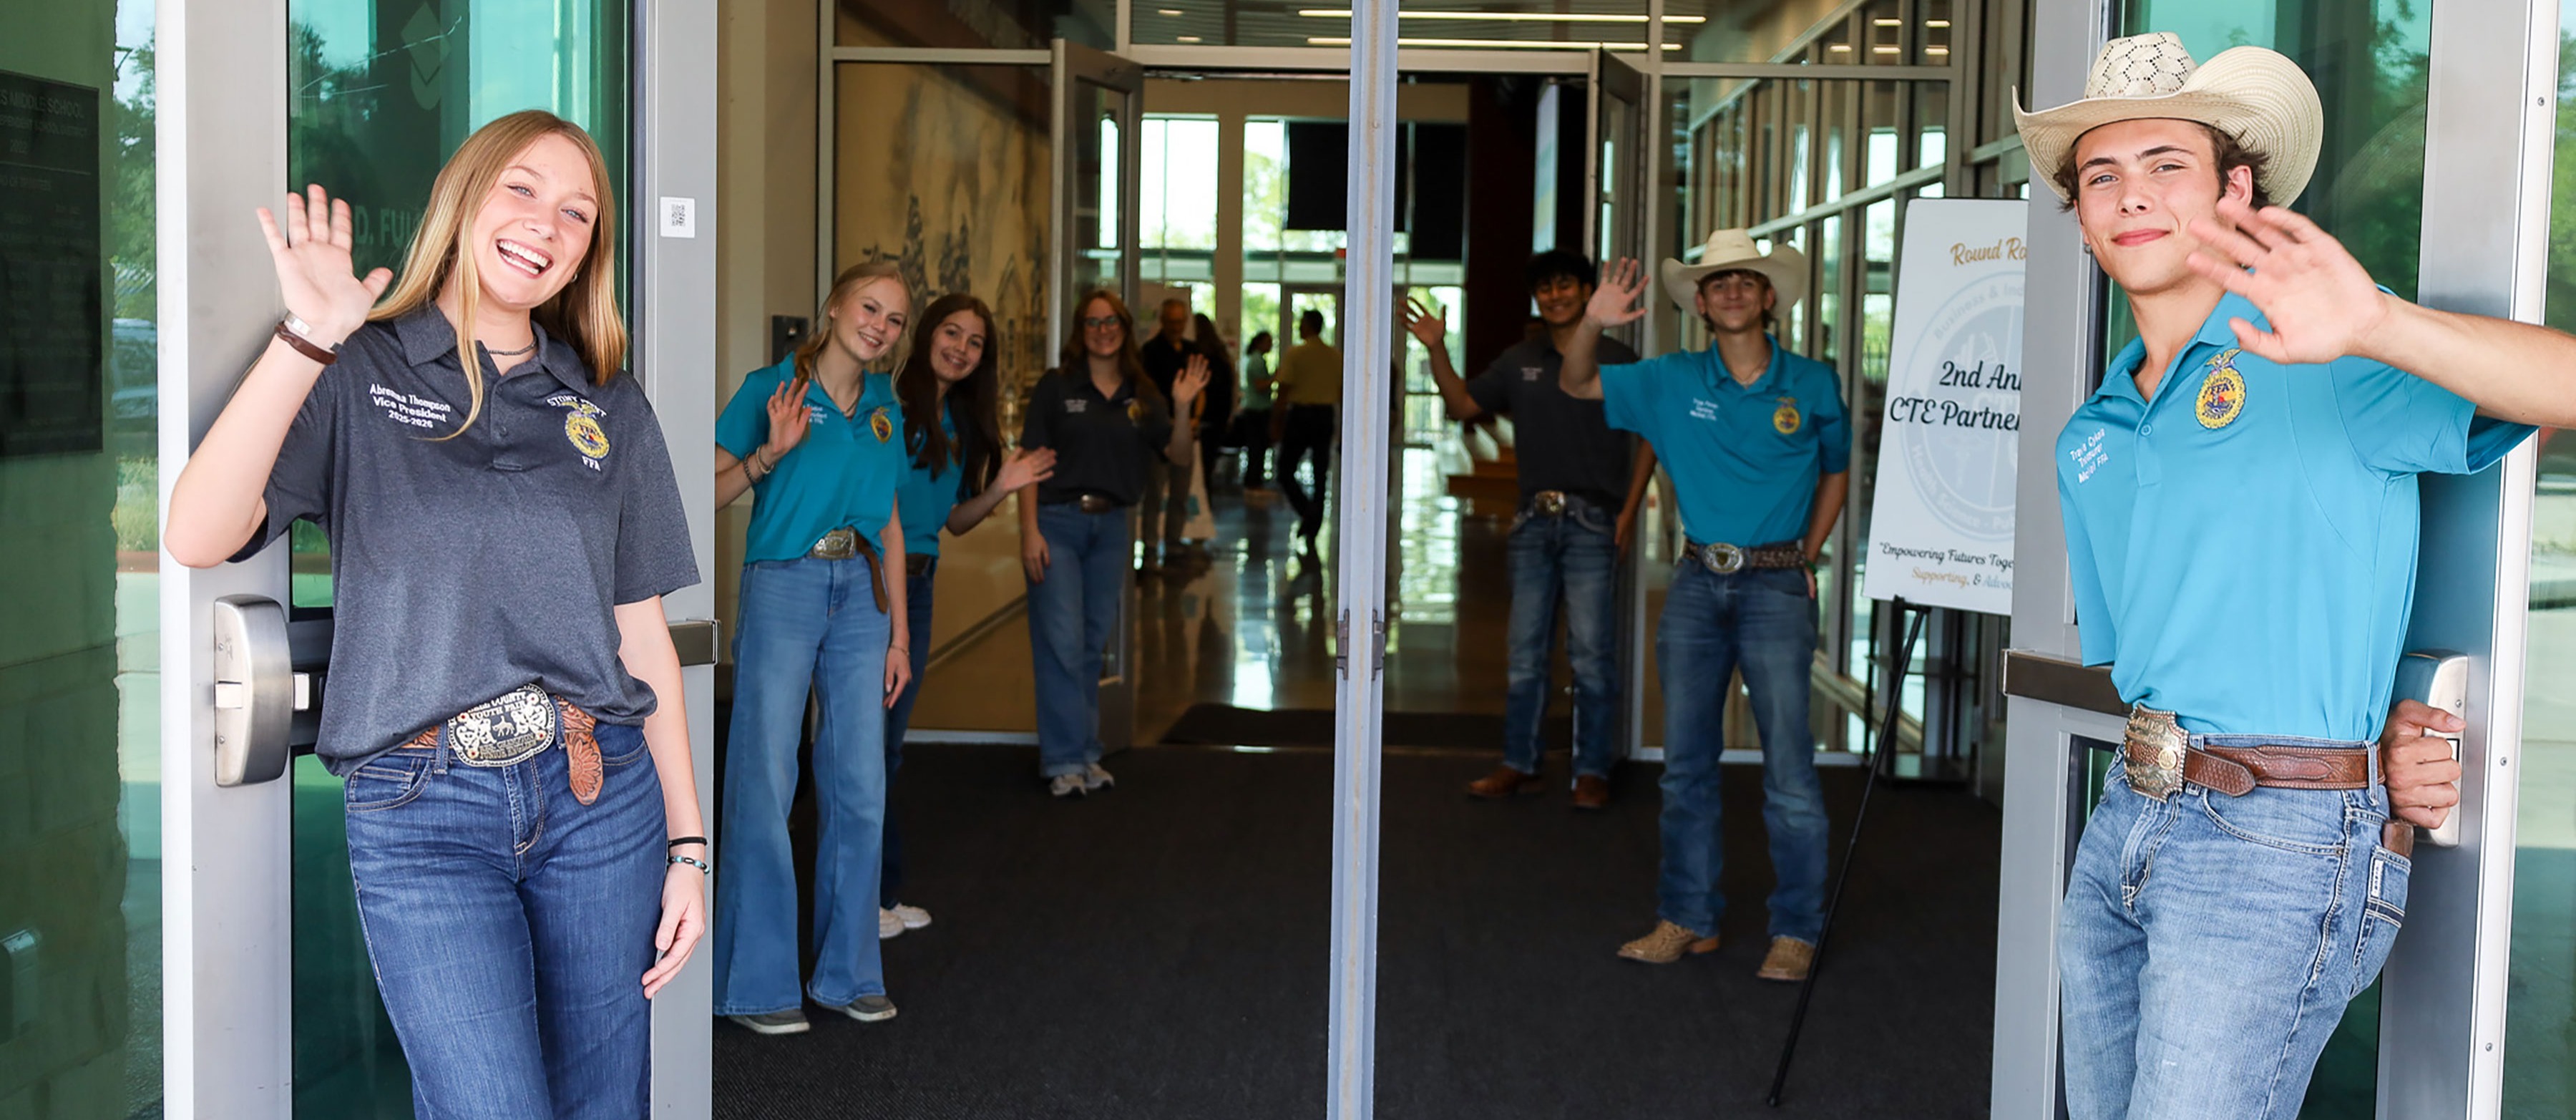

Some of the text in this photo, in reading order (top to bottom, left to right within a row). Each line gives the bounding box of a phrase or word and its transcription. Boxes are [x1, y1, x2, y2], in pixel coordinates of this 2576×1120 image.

[9, 91, 46, 111] MIDDLE
[47, 97, 84, 119] SCHOOL
[1950, 238, 2003, 266] Round
[1939, 360, 1984, 388] 2nd
[2207, 382, 2230, 396] FFA
[373, 395, 447, 422] Vice President
[408, 394, 451, 413] Thompson
[1890, 396, 1936, 424] CTE
[388, 409, 434, 429] 2025-2026
[582, 455, 601, 472] FFA
[1948, 549, 1986, 565] Futures
[1973, 573, 1981, 585] &
[471, 707, 503, 721] YOUTH
